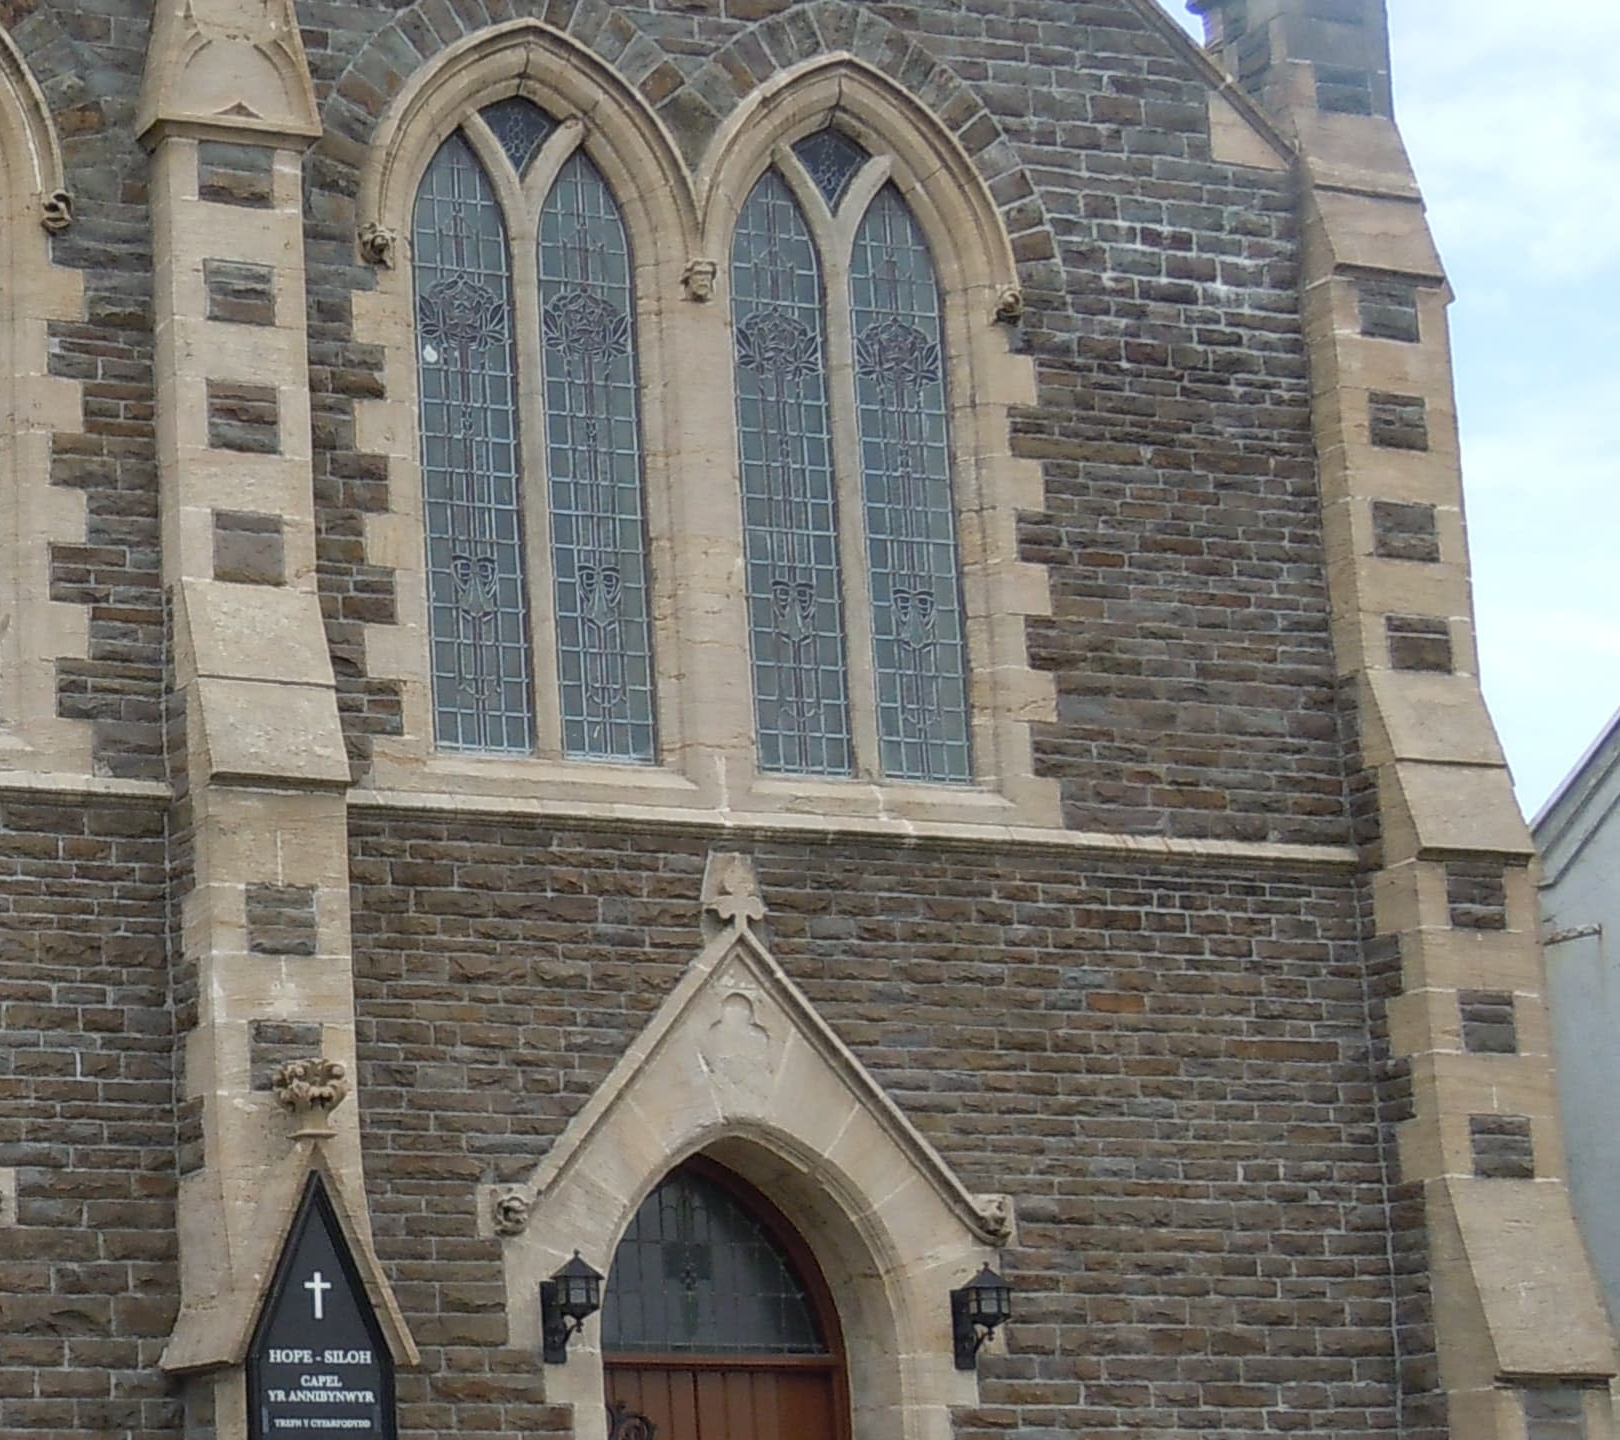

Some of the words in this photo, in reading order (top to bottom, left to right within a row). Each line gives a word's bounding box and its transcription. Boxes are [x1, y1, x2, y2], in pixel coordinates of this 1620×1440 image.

[269, 1350, 313, 1364] HOPE
[324, 1350, 372, 1364] SILOH
[300, 1375, 343, 1387] CAPEL
[267, 1390, 286, 1402] YR
[288, 1390, 375, 1403] ANNIBYNWYR
